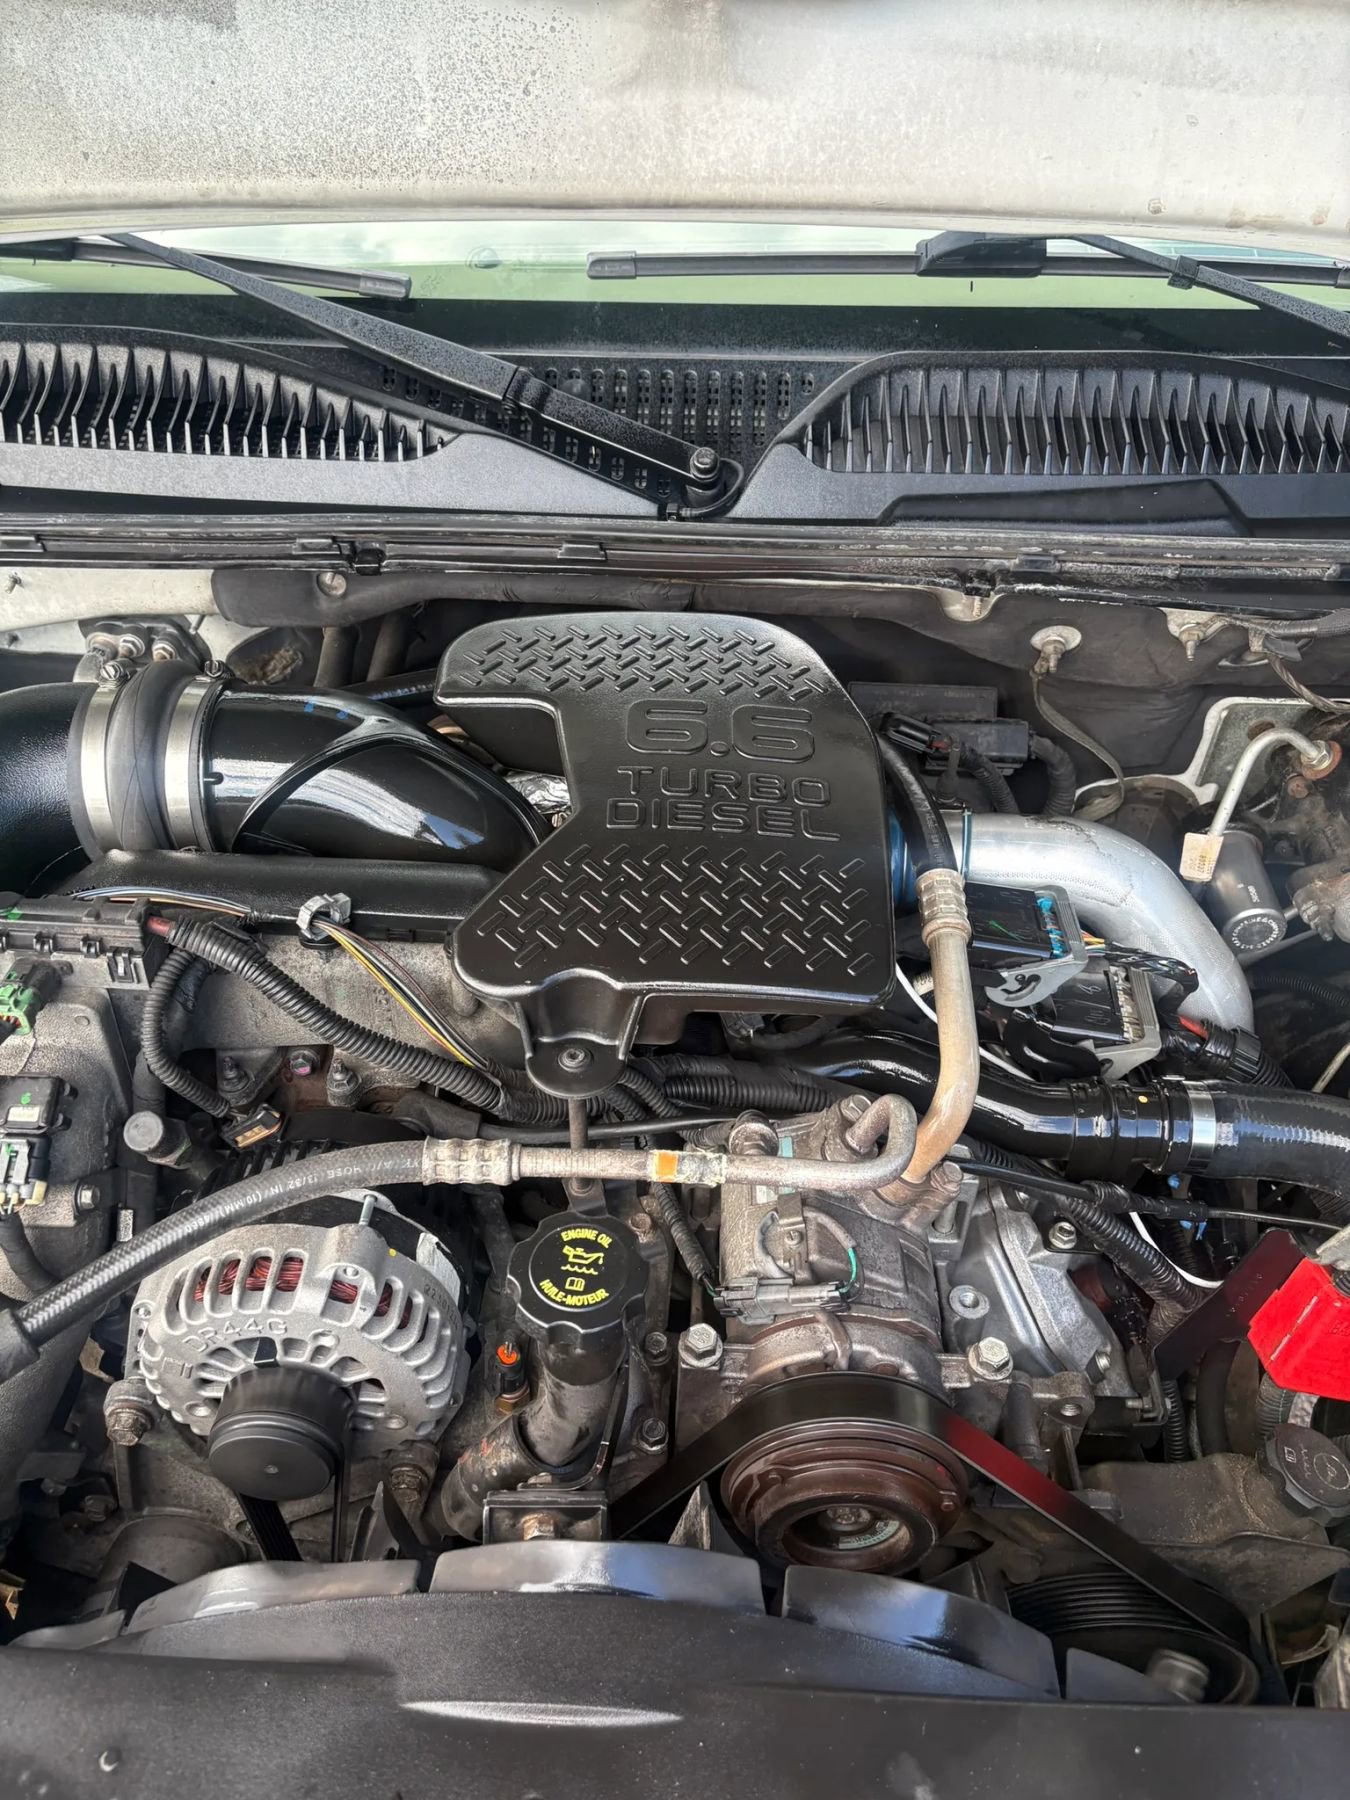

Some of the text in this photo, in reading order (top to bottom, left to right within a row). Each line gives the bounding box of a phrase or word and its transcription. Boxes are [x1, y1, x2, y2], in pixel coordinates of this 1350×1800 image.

[625, 699, 815, 763] 6.6
[617, 765, 831, 808] TURBO
[606, 797, 841, 842] DIESEL
[326, 1165, 362, 1179] HOSE
[560, 1228, 613, 1249] ENGINE OIL
[539, 1278, 610, 1306] HUILE-MOTEUR
[181, 1317, 288, 1353] DR44G
